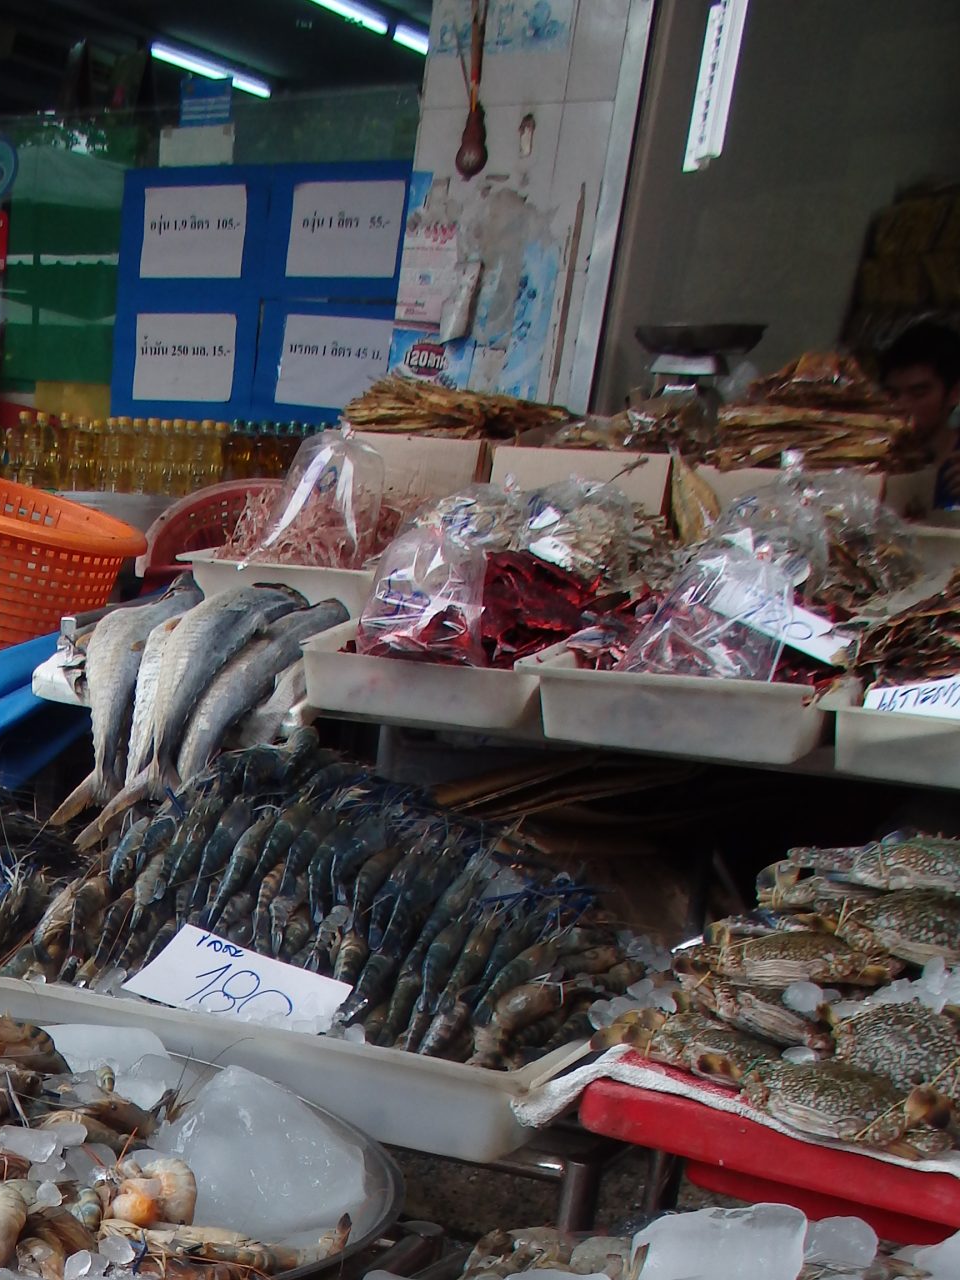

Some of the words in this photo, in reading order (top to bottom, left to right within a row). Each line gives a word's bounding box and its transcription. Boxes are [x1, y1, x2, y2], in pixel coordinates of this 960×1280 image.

[190, 214, 210, 231] ลิตร
[337, 210, 359, 229] ลิตร
[141, 335, 168, 356] น้ำมัน
[171, 345, 189, 357] 250
[289, 343, 319, 355] มรกต
[331, 340, 352, 358] ลิตร
[355, 347, 368, 359] 45
